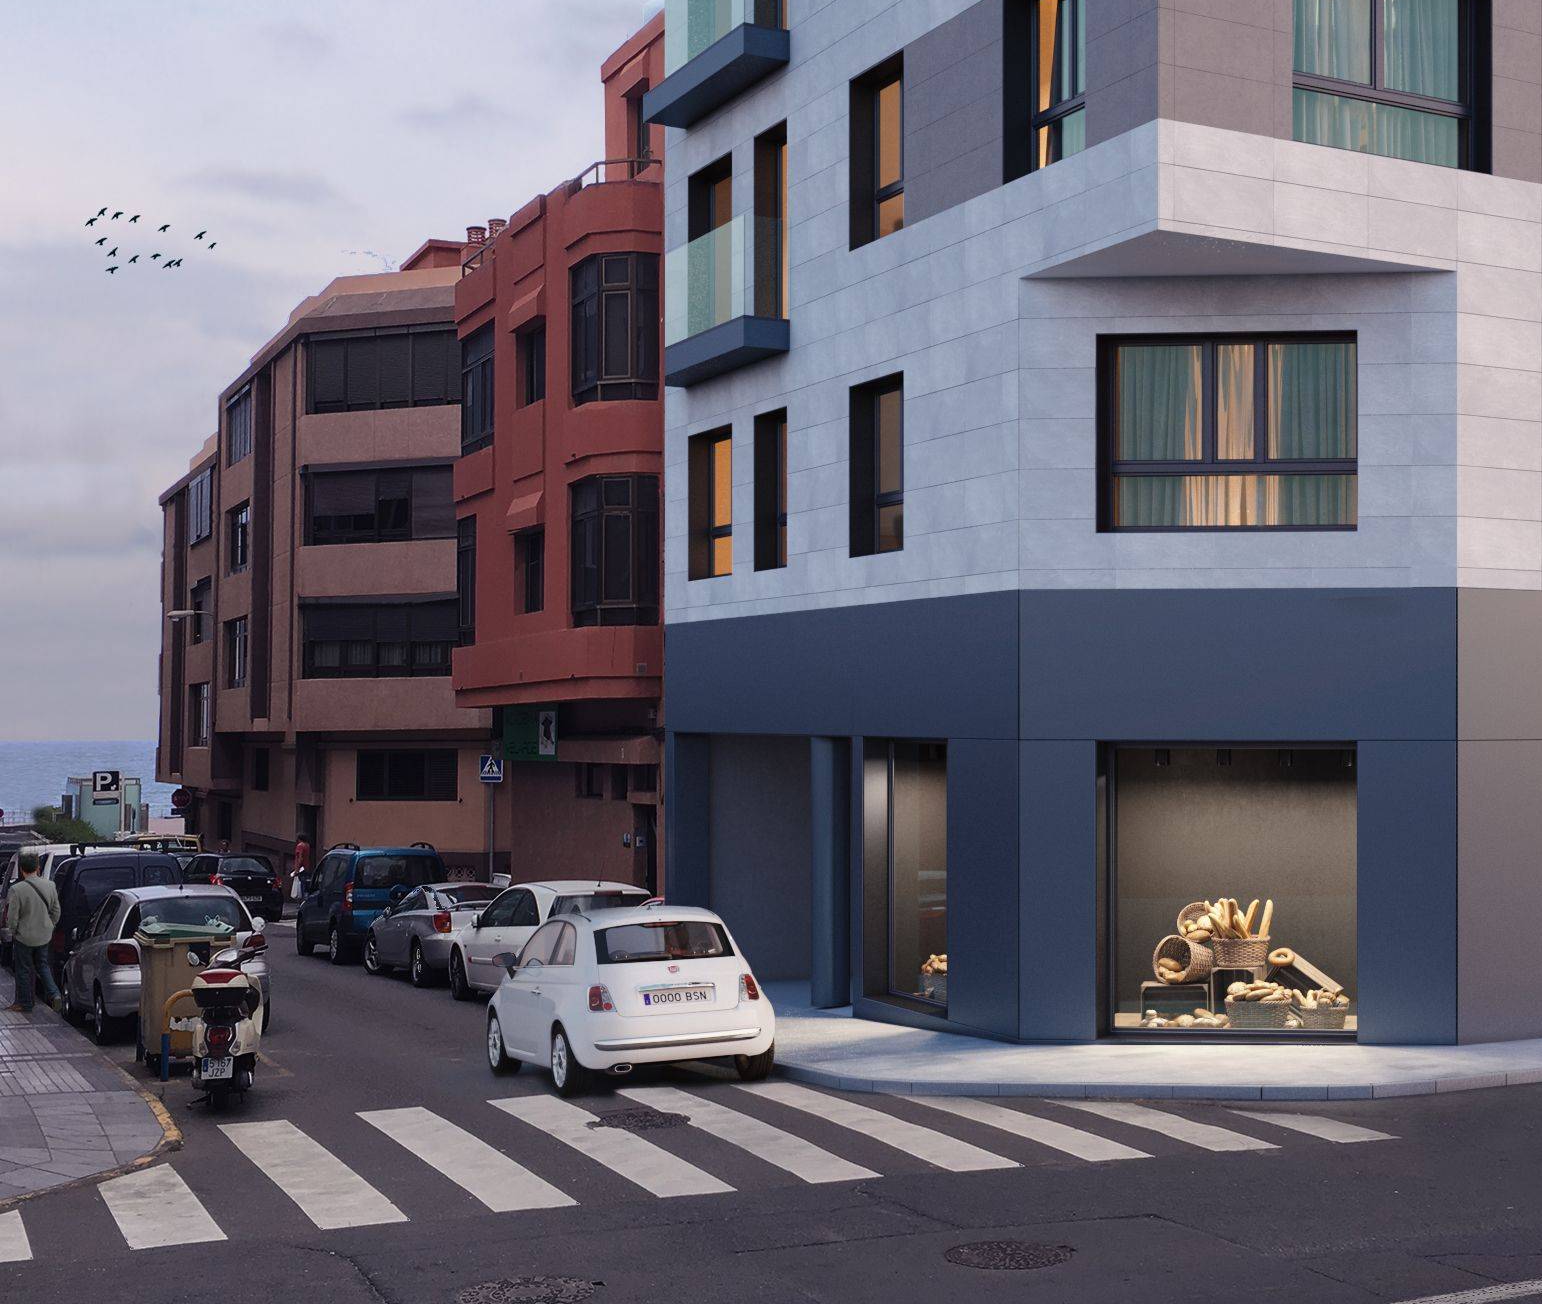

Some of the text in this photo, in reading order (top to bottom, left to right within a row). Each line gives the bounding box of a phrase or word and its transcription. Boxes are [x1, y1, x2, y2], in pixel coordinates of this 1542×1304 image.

[653, 991, 707, 1004] 0000 BSN
[209, 1058, 232, 1069] 5167
[209, 1067, 226, 1078] JZP
